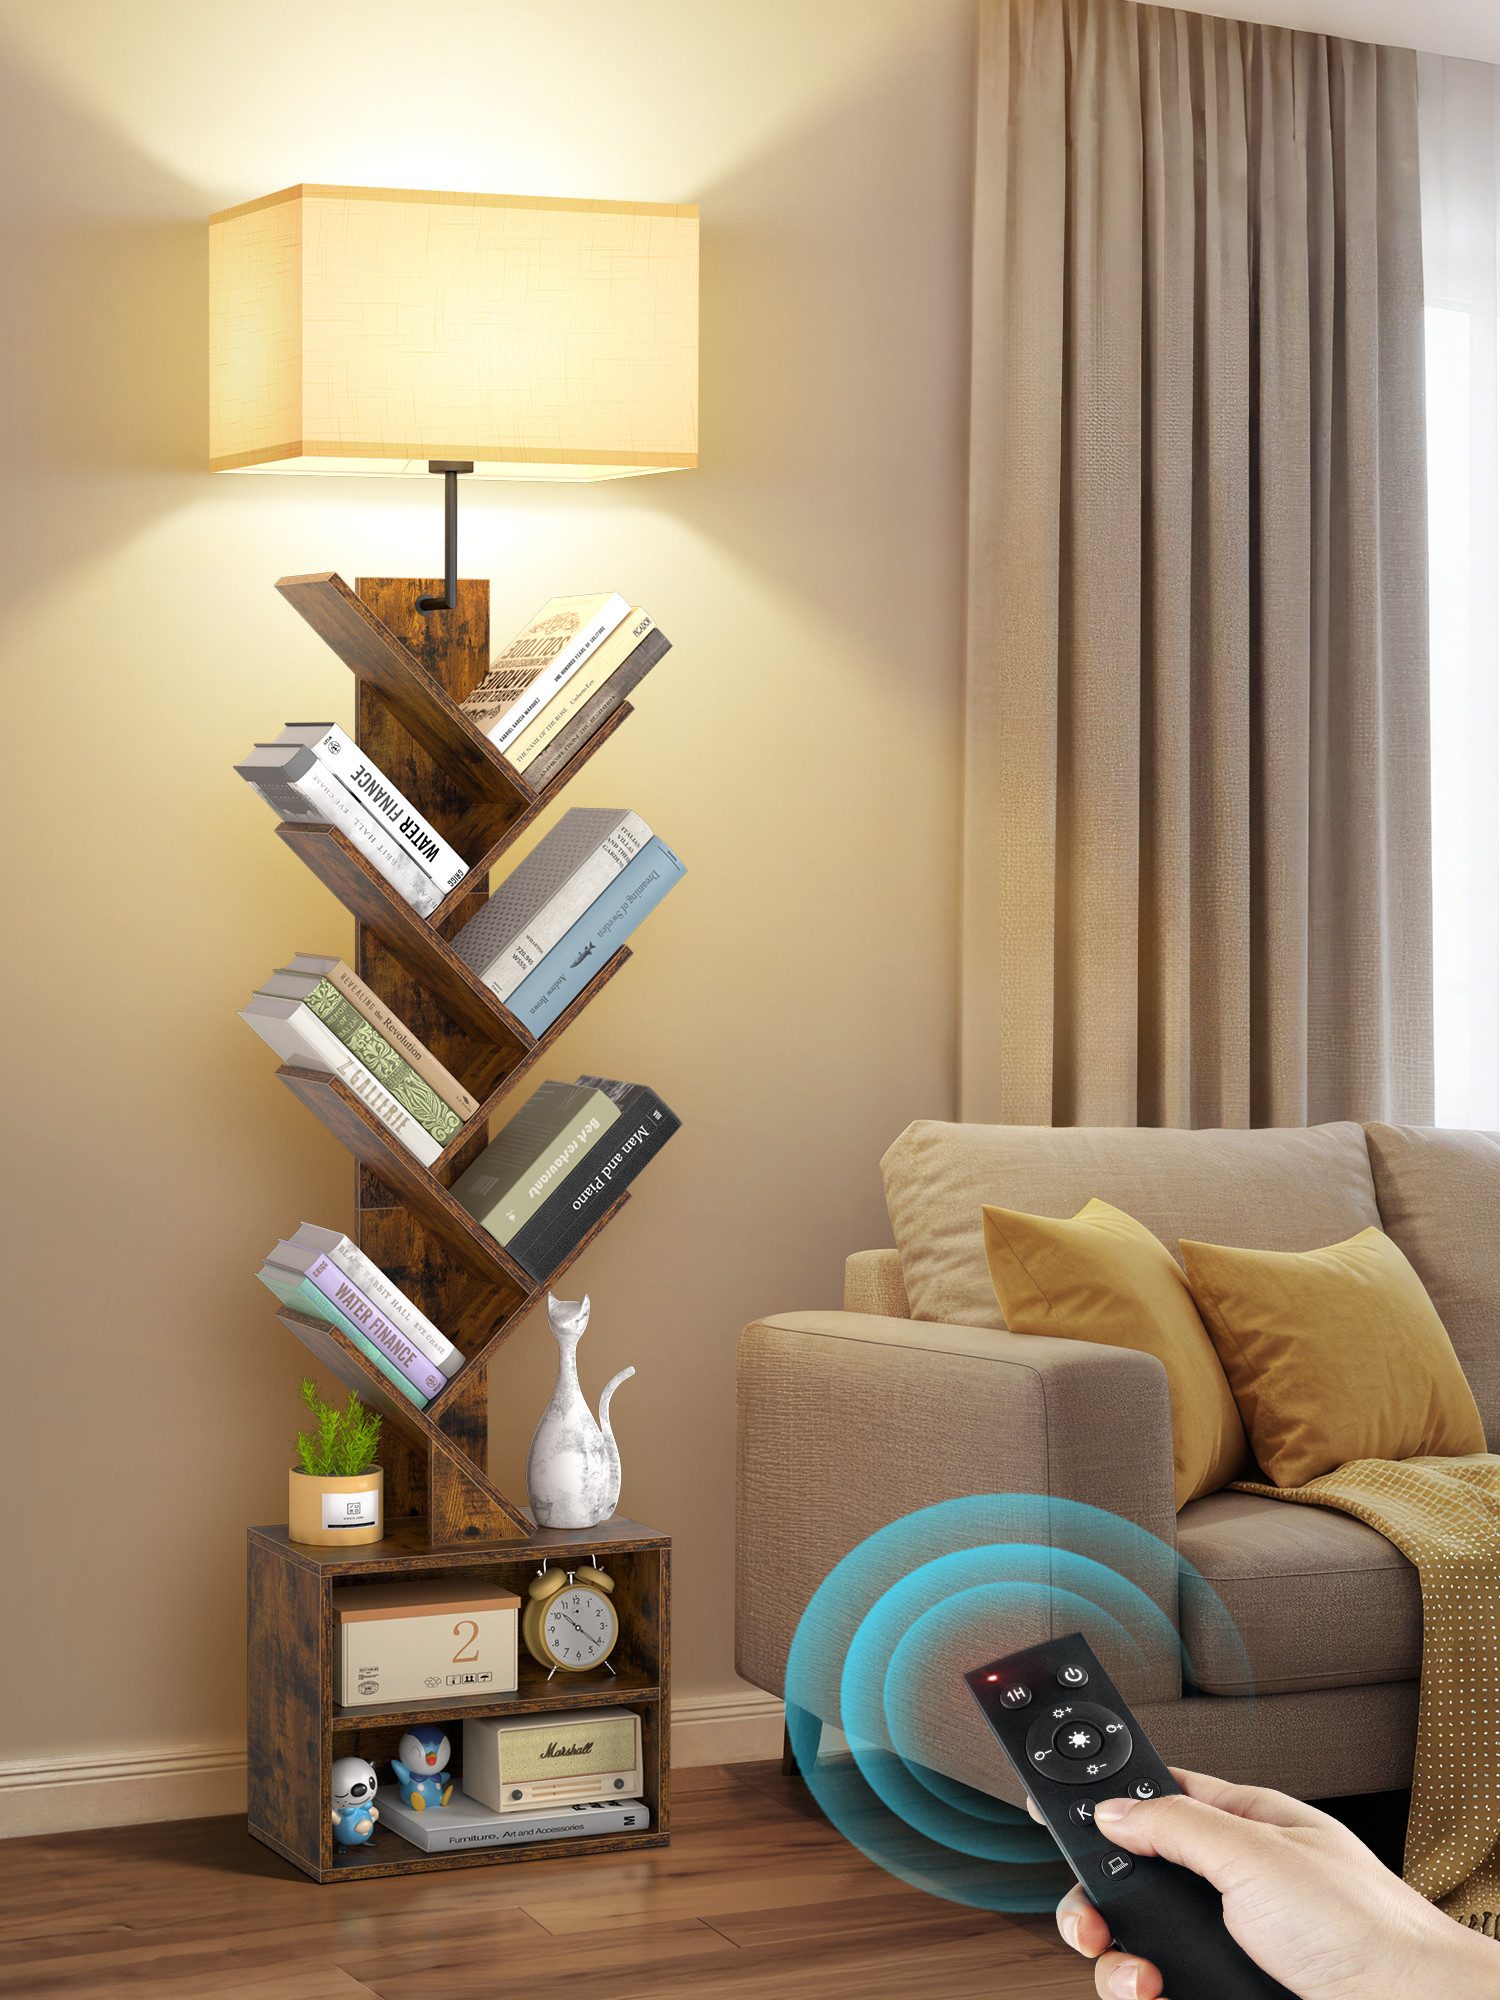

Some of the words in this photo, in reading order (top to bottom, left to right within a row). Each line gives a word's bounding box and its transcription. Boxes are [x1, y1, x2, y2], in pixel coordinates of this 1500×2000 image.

[633, 617, 650, 637] PICADOR
[501, 636, 571, 659] SOLITUDE
[553, 673, 562, 682] ONE
[561, 658, 575, 675] HUNDRED
[574, 646, 587, 660] YEARS
[589, 626, 604, 642] SOLITUDE
[499, 727, 513, 742] GABRIEL
[515, 749, 528, 763] THE
[526, 736, 540, 752] NAME
[538, 728, 548, 739] OF
[544, 718, 557, 732] THE
[554, 707, 568, 720] ROSE
[313, 774, 334, 798] CHASE
[350, 764, 404, 822] FINANCE
[353, 816, 375, 842] HALL
[399, 815, 440, 862] WATER
[620, 826, 641, 848] ITALIAN
[605, 836, 619, 849] AND
[616, 834, 634, 853] VILLAS
[448, 870, 463, 886] GRIGG
[626, 869, 660, 905] Dreaming
[617, 900, 630, 916] of
[596, 910, 624, 938] Sweden
[544, 973, 567, 998] Andrew
[339, 972, 375, 1011] REVEALING
[374, 1009, 383, 1021] the
[383, 1017, 422, 1060] Revolution
[529, 994, 549, 1015] Brown
[577, 1117, 601, 1143] Best
[622, 1125, 650, 1154] Man
[528, 1139, 579, 1199] restaurants
[602, 1154, 623, 1181] and
[572, 1177, 605, 1211] Piano
[313, 1262, 327, 1278] GRIGG
[390, 1299, 411, 1320] HALL
[334, 1282, 373, 1324] WATER
[368, 1316, 417, 1368] FINANCE
[413, 1322, 426, 1335] EVE
[425, 1334, 444, 1354] CHASE
[561, 1601, 568, 1609] 11
[452, 1620, 480, 1664] 2
[1007, 1687, 1026, 1702] 1H
[540, 1742, 594, 1759] Marshall
[1076, 1803, 1092, 1821] K
[449, 1833, 499, 1845] Furniture,
[502, 1829, 516, 1838] Art
[517, 1827, 535, 1838] and
[536, 1823, 585, 1835] Accessories
